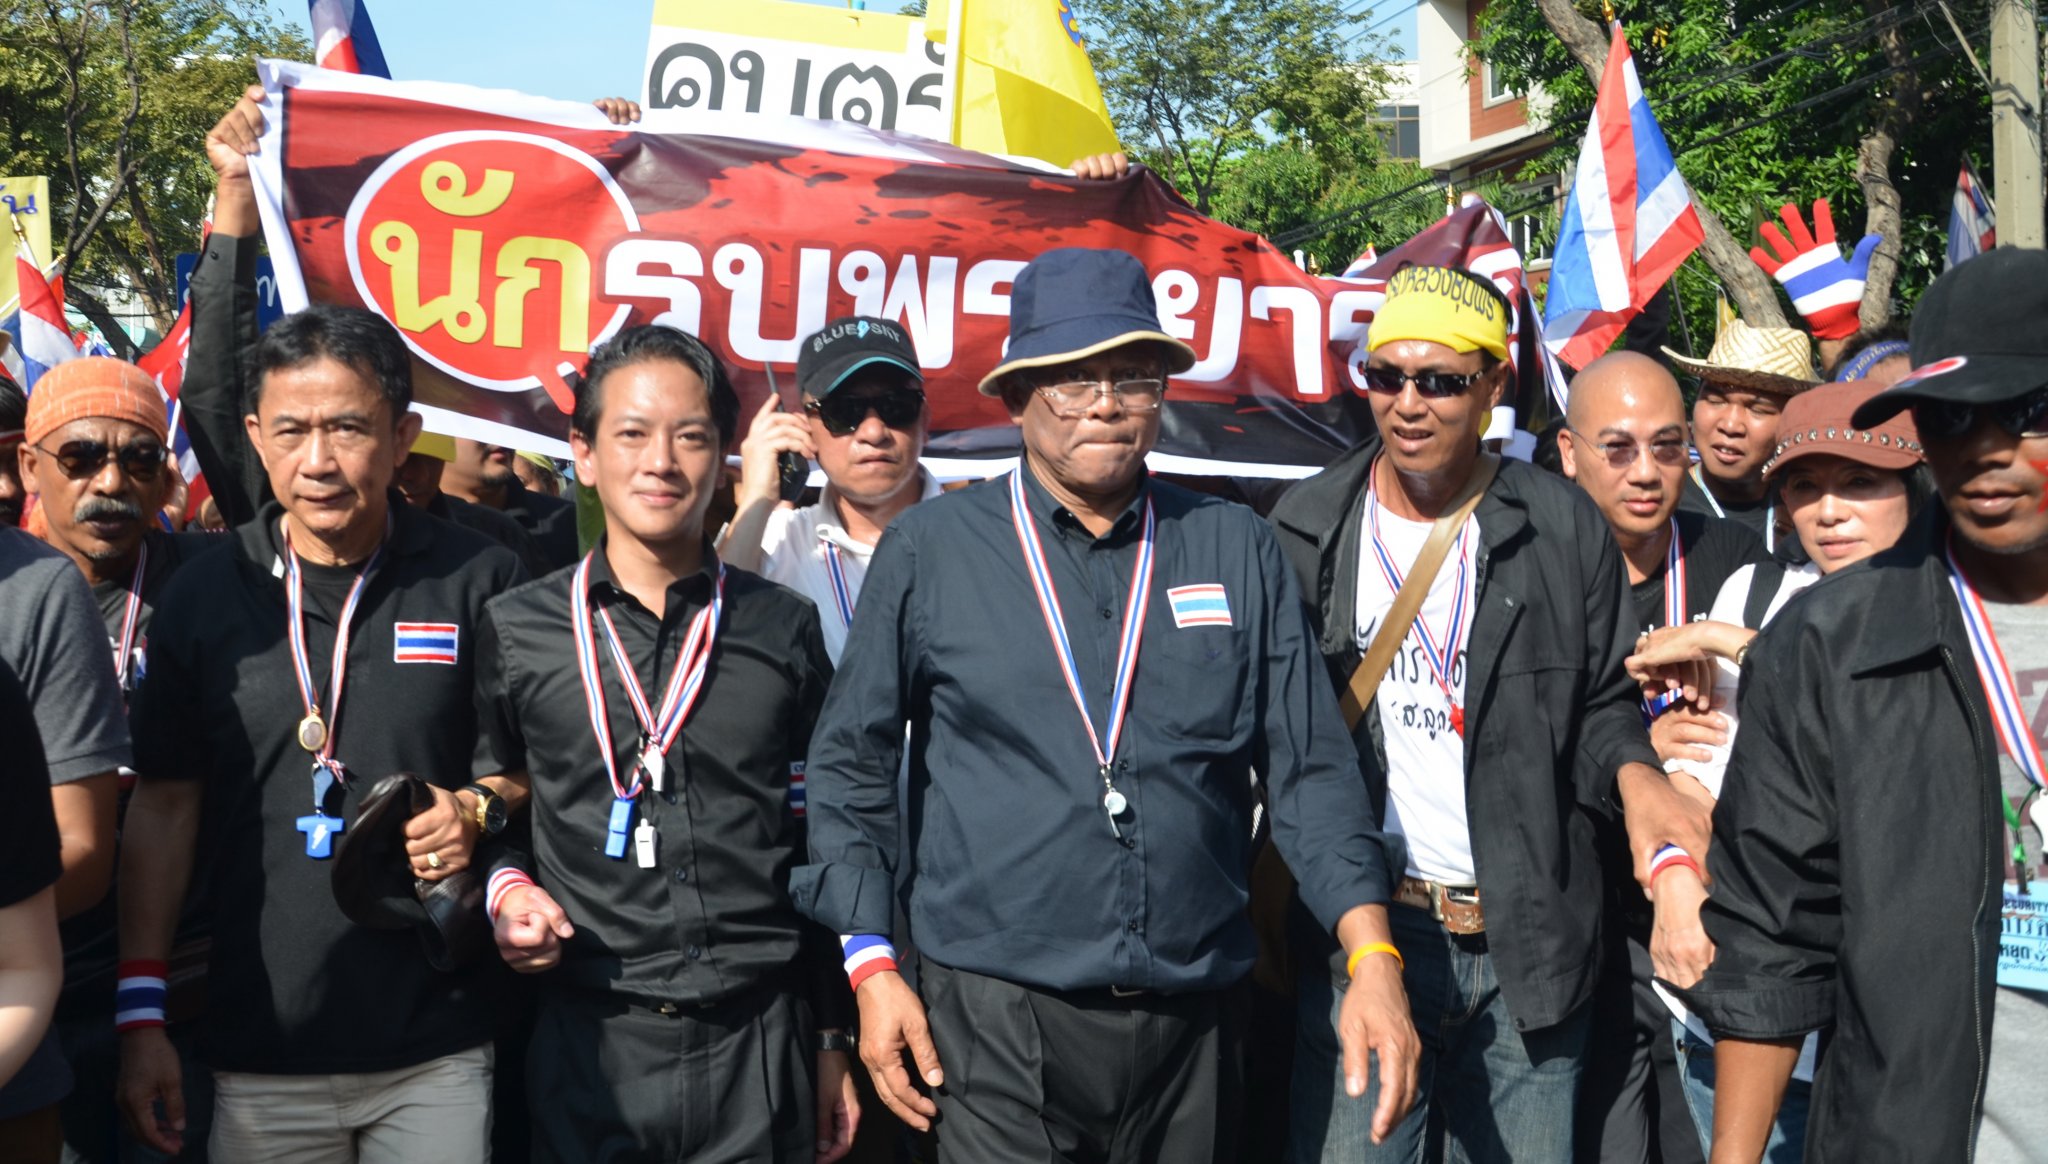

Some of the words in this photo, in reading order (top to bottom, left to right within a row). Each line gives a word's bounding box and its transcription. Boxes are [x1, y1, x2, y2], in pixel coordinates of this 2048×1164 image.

[812, 324, 858, 353] BLUE
[870, 322, 901, 344] SKY
[2002, 898, 2048, 913] ECURITY
